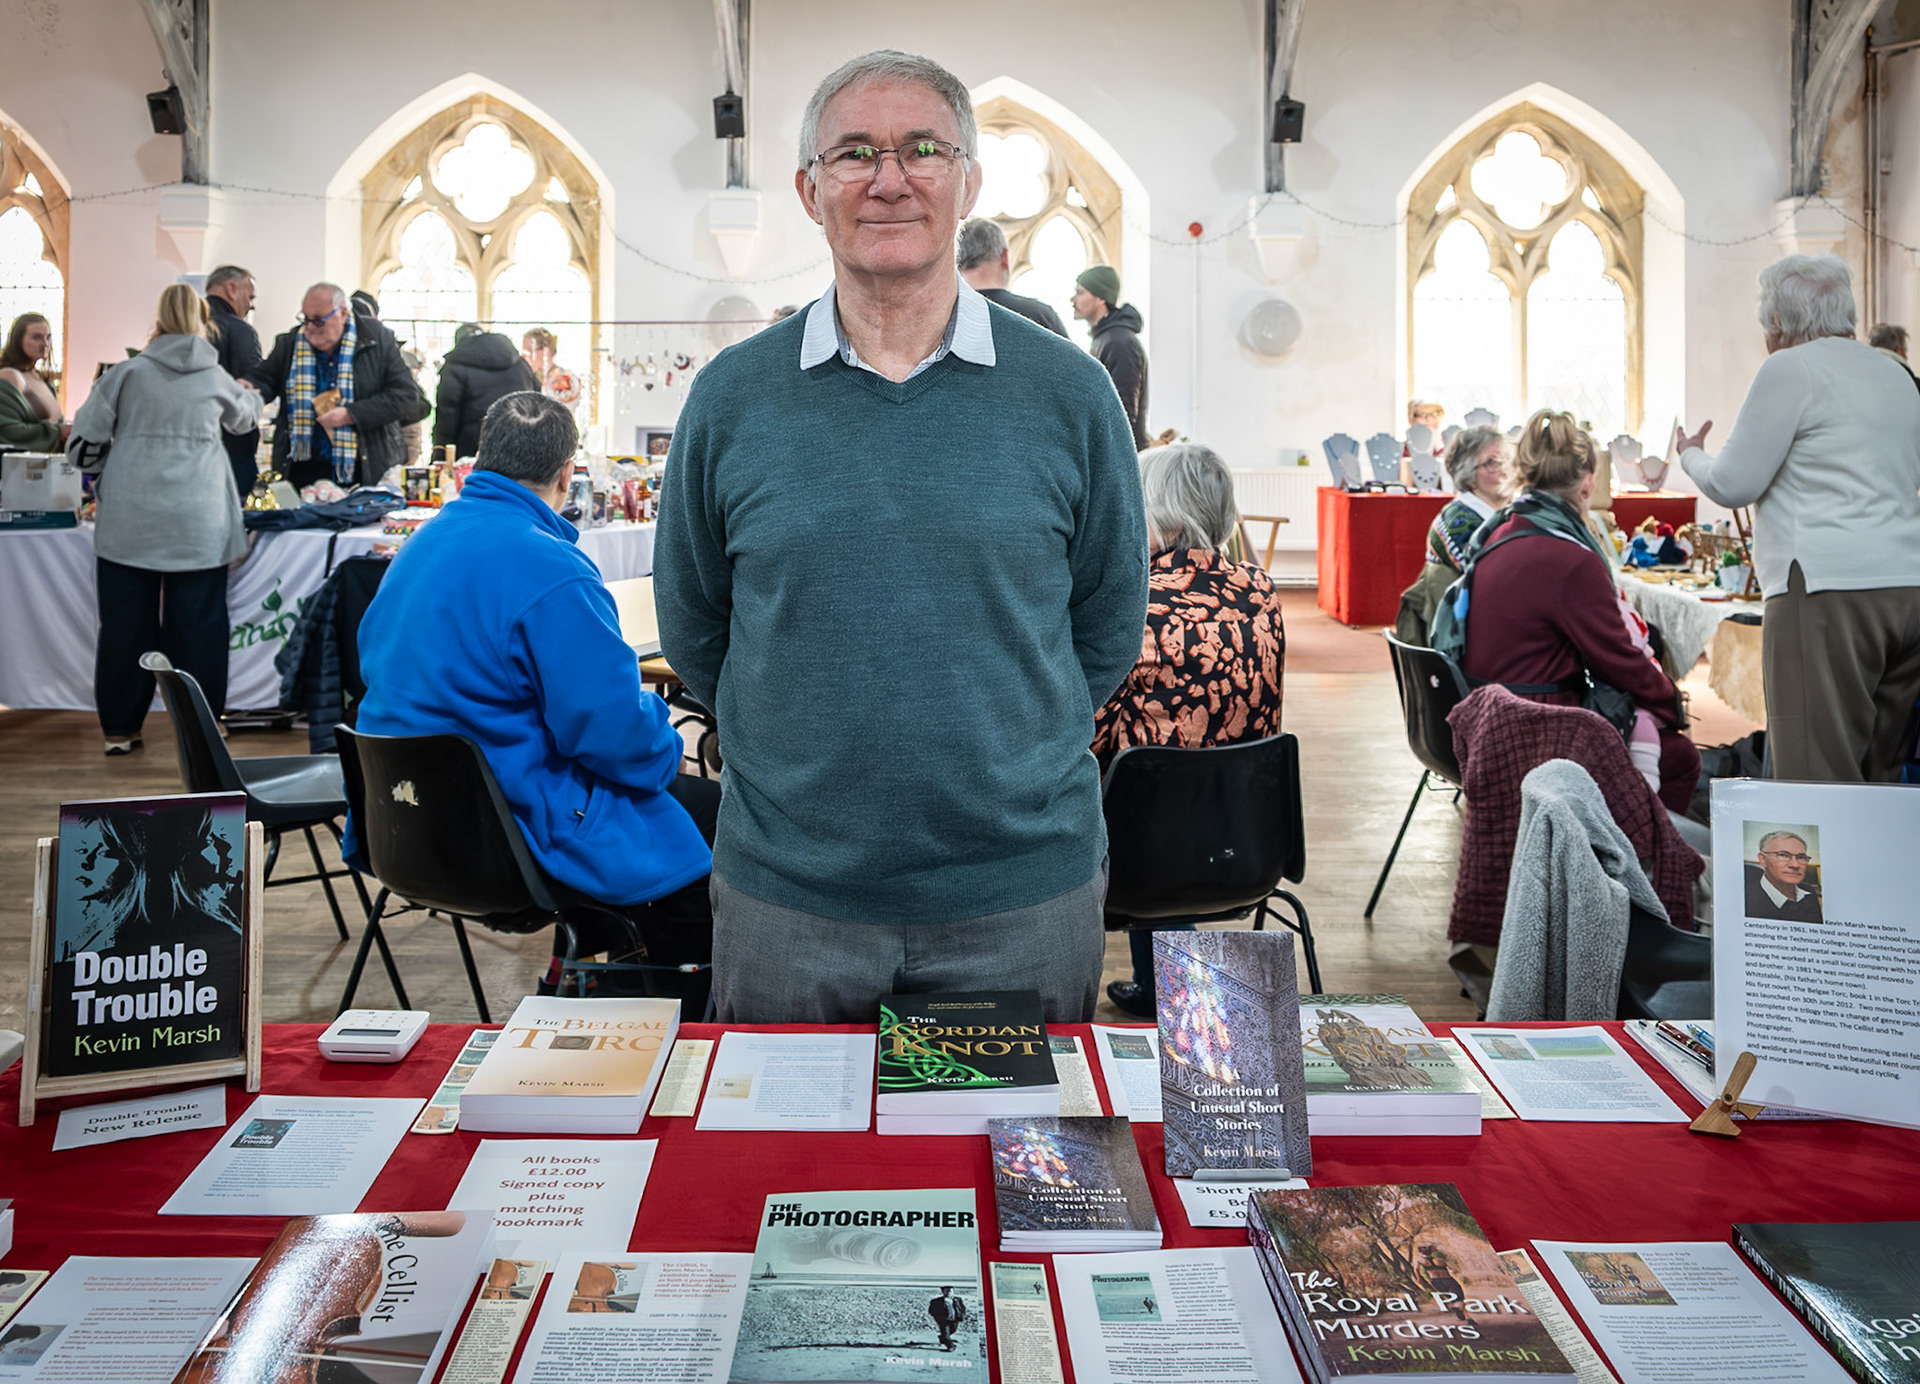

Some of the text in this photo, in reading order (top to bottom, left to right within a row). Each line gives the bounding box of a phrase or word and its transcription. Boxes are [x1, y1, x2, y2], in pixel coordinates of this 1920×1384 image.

[1743, 921, 1780, 932] Canterbury
[1819, 927, 1835, 936] lived
[1878, 933, 1900, 942] school
[1824, 918, 1843, 927] Kevin
[1844, 920, 1865, 929] Marsh
[1881, 923, 1898, 932] born
[1744, 931, 1775, 942] attending
[1776, 933, 1788, 941] the
[1789, 934, 1820, 944] Technical
[1867, 941, 1906, 954] Canterbury
[1754, 943, 1788, 951] apprentice
[1790, 944, 1808, 953] sheet
[1810, 947, 1829, 955] metal
[1858, 951, 1880, 962] During
[1881, 953, 1892, 962] his
[1893, 954, 1906, 963] five
[73, 943, 207, 987] Double
[1744, 950, 1770, 961] training
[1780, 954, 1806, 963] worked
[1821, 958, 1839, 966] small
[1840, 959, 1856, 968] local
[1857, 962, 1888, 973] company
[1889, 964, 1905, 973] with
[1906, 966, 1917, 974] his
[1795, 964, 1811, 973] 1981
[1837, 970, 1864, 979] married
[1880, 975, 1904, 984] moved
[1824, 978, 1843, 987] home
[71, 981, 218, 1026] Trouble
[562, 1019, 669, 1030] BELGAE
[890, 1023, 1040, 1036] GORDIAN
[1746, 1010, 1764, 1019] three
[1794, 1016, 1807, 1024] The
[1839, 1021, 1852, 1030] The
[1853, 1023, 1874, 1033] Cellist
[1890, 1027, 1903, 1036] The
[1300, 1028, 1426, 1037] ORDIAN
[74, 1024, 220, 1057] Kevin Marsh
[886, 1036, 1043, 1056] KNOT
[1233, 1068, 1240, 1079] A
[1194, 1084, 1279, 1097] Collection of
[88, 1103, 199, 1126] Double Trouble
[1191, 1101, 1284, 1114] Unusual Short
[82, 1112, 202, 1136] New Release
[1216, 1119, 1262, 1130] Stories
[1204, 1146, 1280, 1158] Kevin Marsh
[550, 1156, 600, 1164] books
[499, 1180, 605, 1189] Signed copy
[1032, 1186, 1122, 1195] Collection of
[528, 1192, 566, 1201] plus
[1028, 1194, 1128, 1203] Unusual Short
[500, 1205, 584, 1215] matching
[770, 1204, 802, 1212] THE
[1209, 1210, 1246, 1218] £5.0
[767, 1210, 975, 1228] PHOTOGRAPHER
[1043, 1215, 1126, 1224] Kevin Marsh
[1290, 1270, 1338, 1291] The
[370, 1254, 418, 1322] Cellist
[1738, 1236, 1775, 1280] AGAINST
[1777, 1275, 1805, 1314] THEIR
[1806, 1308, 1829, 1341] WILL
[1300, 1292, 1530, 1317] Royal Park
[1312, 1319, 1482, 1341] Murders
[1347, 1344, 1542, 1363] Kevin Marsh
[886, 1355, 972, 1368] Kevin Marsh
